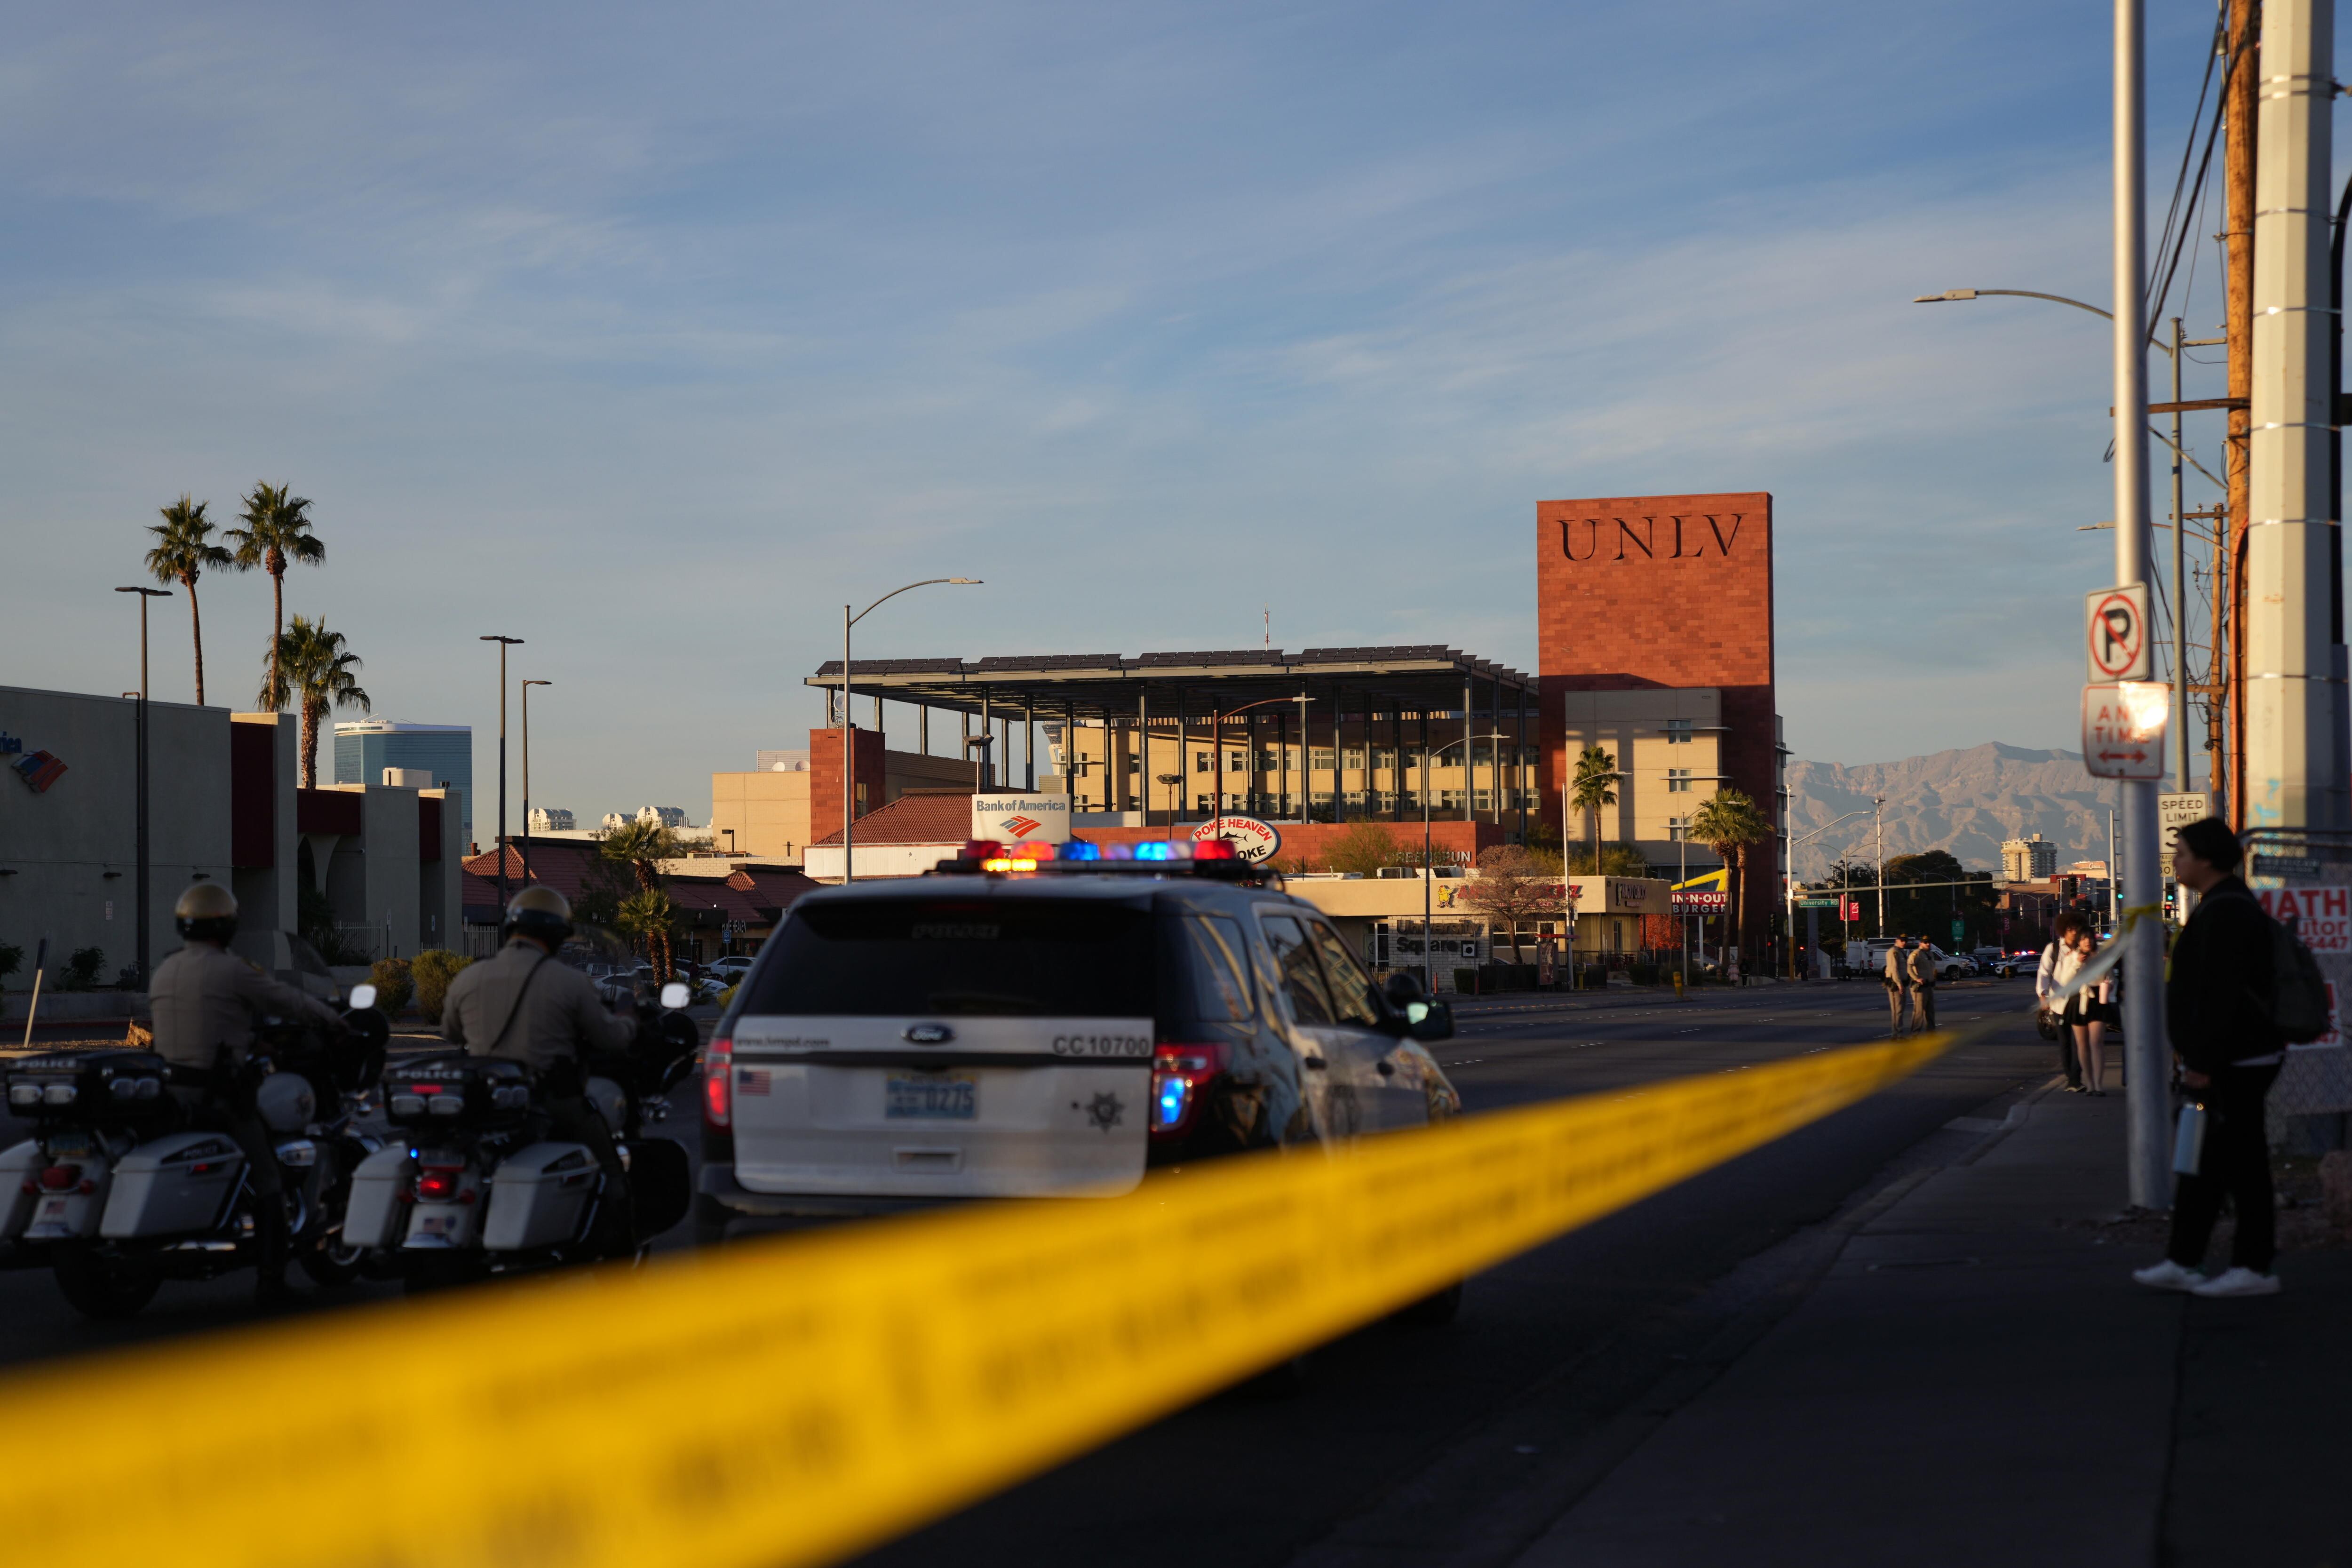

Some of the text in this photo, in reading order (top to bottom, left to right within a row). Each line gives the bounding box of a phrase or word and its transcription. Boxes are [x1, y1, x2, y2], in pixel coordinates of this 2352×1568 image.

[1557, 513, 1747, 561] UNLV
[977, 800, 1065, 811] Bank of America
[2162, 800, 2203, 810] SPEED
[2166, 813, 2198, 822] LIMIT
[1194, 819, 1272, 841] POKE HEAVEN
[2166, 827, 2182, 847] 3
[1237, 845, 1266, 860] OKE
[1672, 894, 1725, 903] IN-N-OUT
[1673, 904, 1725, 913] BURGER
[911, 923, 1000, 939] POLICE
[2296, 918, 2347, 935] utor
[16, 1059, 77, 1068] POLICE
[396, 1068, 463, 1080] POLICE
